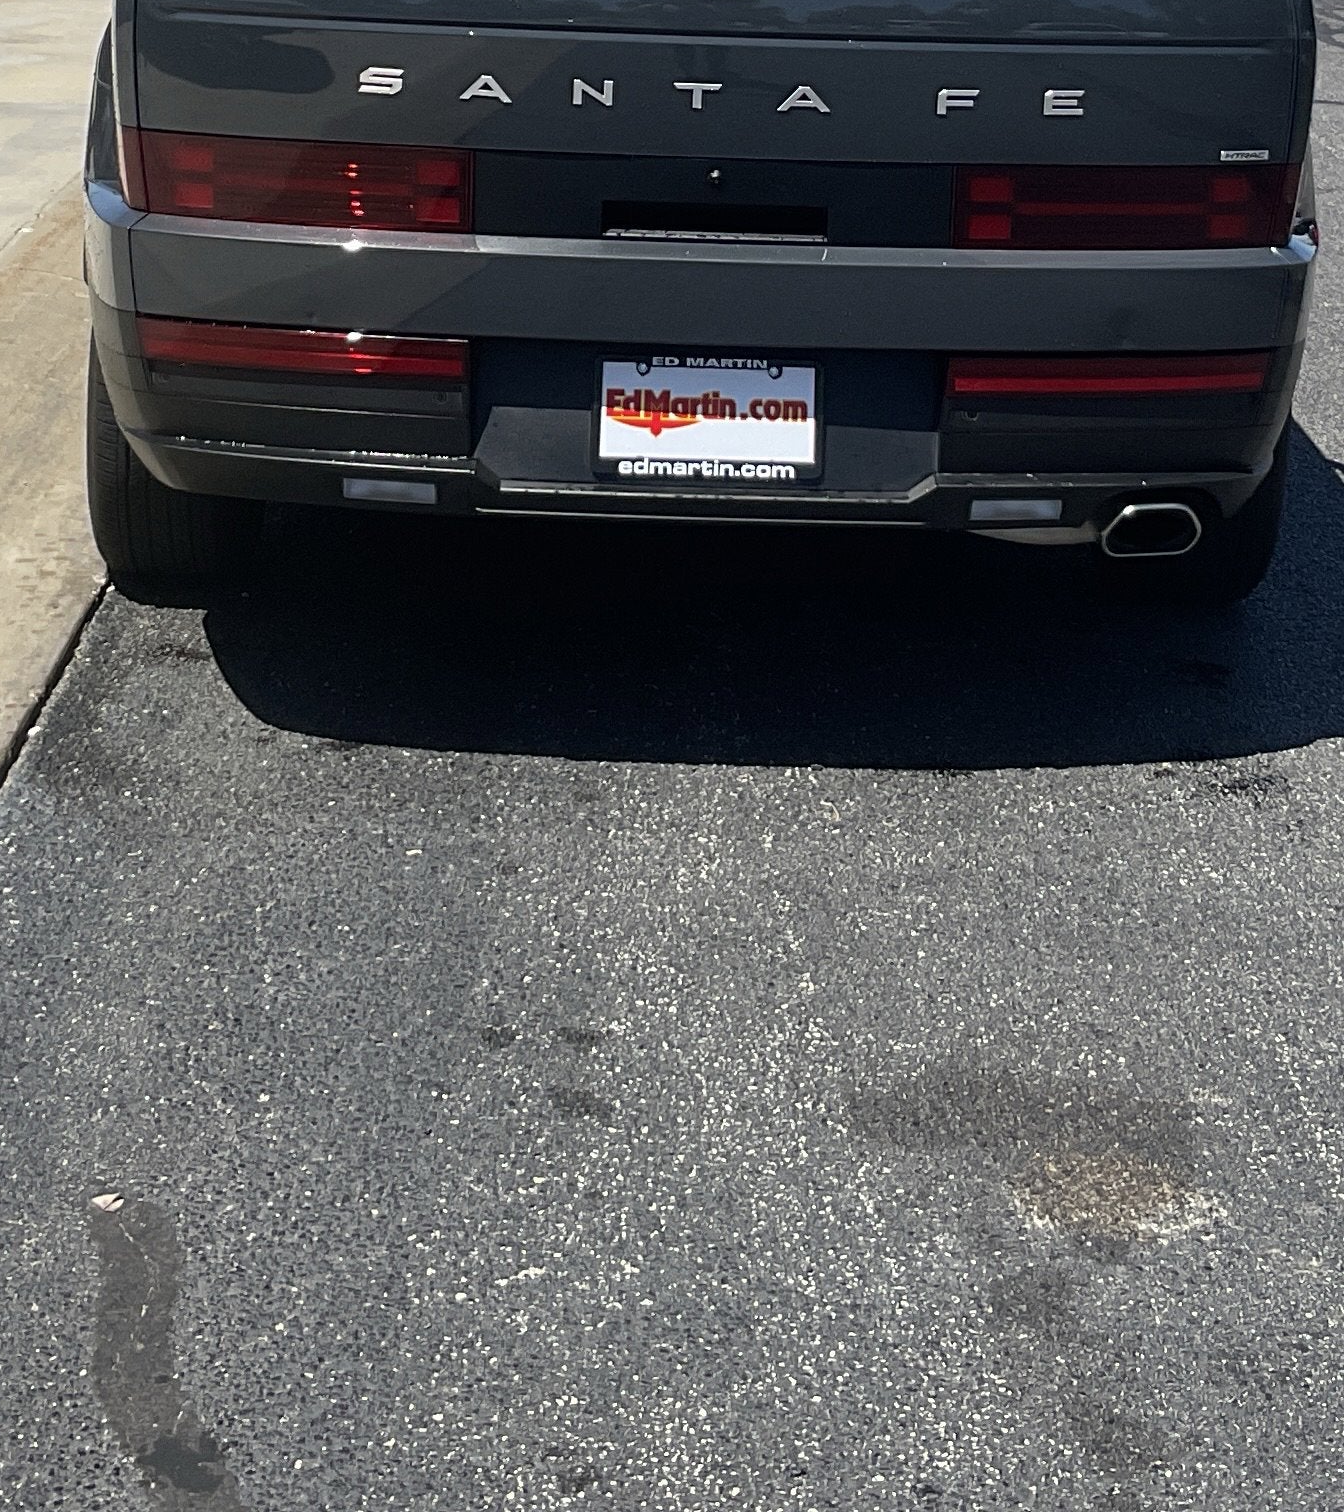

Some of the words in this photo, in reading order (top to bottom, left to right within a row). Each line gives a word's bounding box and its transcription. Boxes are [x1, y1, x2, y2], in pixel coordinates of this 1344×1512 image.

[357, 65, 832, 114] SANTA
[936, 88, 1086, 116] FE
[652, 356, 680, 367] ED
[686, 358, 768, 369] MARTIN
[617, 456, 797, 480] edmartin.com
